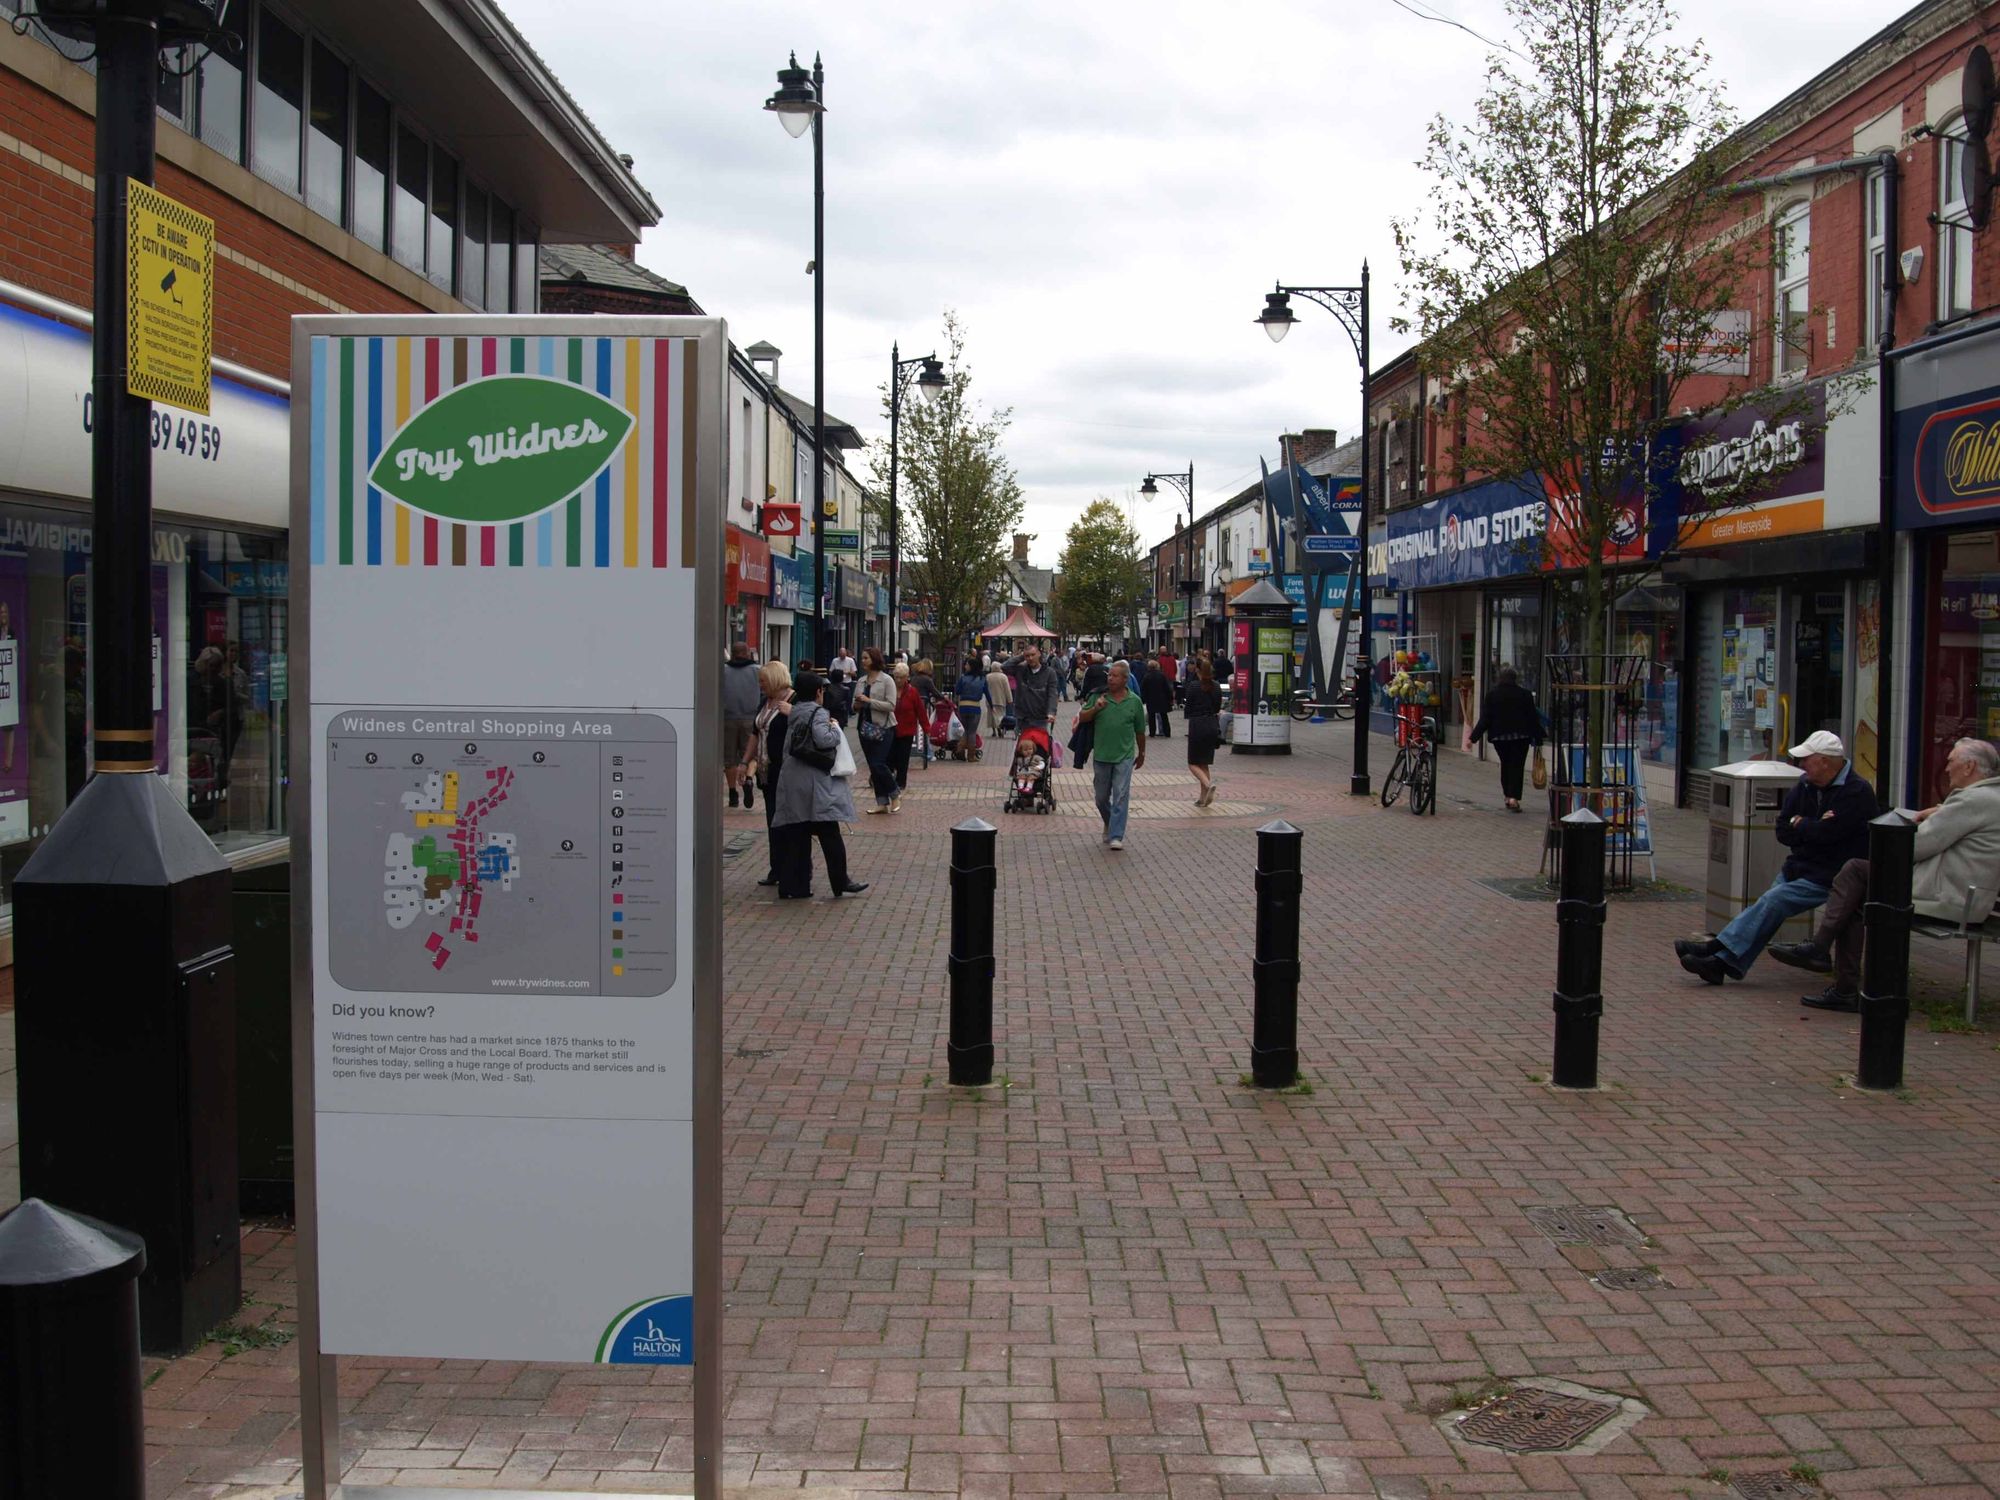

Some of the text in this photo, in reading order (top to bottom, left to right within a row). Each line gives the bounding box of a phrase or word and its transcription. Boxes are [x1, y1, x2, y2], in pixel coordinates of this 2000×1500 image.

[157, 222, 188, 249] BE AWARE
[142, 235, 200, 274] CCTV IN OPERATION
[176, 418, 196, 456] 49
[202, 423, 220, 462] 59
[395, 418, 608, 482] Try Widnes
[1311, 484, 1328, 511] alber
[1388, 502, 1546, 565] ORIGINAL POUND STORE
[1712, 516, 1772, 538] Greater Merseyside
[342, 717, 613, 738] Widnes Central Shopping Area
[492, 978, 590, 988] www.trywidnes.com
[332, 1004, 435, 1019] Did you know?
[332, 1032, 368, 1042] Widnes
[370, 1033, 394, 1042] town
[396, 1034, 426, 1043] centre
[430, 1034, 446, 1044] has
[450, 1034, 468, 1044] had
[480, 1035, 512, 1044] market
[516, 1036, 542, 1046] since
[545, 1036, 568, 1046] 1875
[572, 1038, 604, 1046] thanks
[607, 1038, 616, 1047] to
[620, 1038, 636, 1048] the
[332, 1044, 628, 1060] foresight of Major Cross and the Local Board. The market still
[332, 1056, 378, 1066] flourishes
[381, 1058, 410, 1068] today,
[414, 1058, 444, 1070] selling
[456, 1060, 480, 1070] huge
[483, 1062, 510, 1072] range
[514, 1062, 524, 1070] of
[526, 1062, 569, 1072] products
[572, 1062, 590, 1072] and
[593, 1063, 634, 1072] services
[636, 1064, 655, 1072] and
[658, 1064, 666, 1073] is
[332, 1070, 356, 1078] open
[359, 1069, 376, 1078] five
[379, 1070, 402, 1080] days
[404, 1072, 420, 1080] per
[423, 1071, 448, 1080] week
[451, 1071, 478, 1082] (Mon,
[481, 1072, 503, 1082] Wed
[513, 1074, 536, 1083] Sat).
[633, 1342, 680, 1352] HALTON
